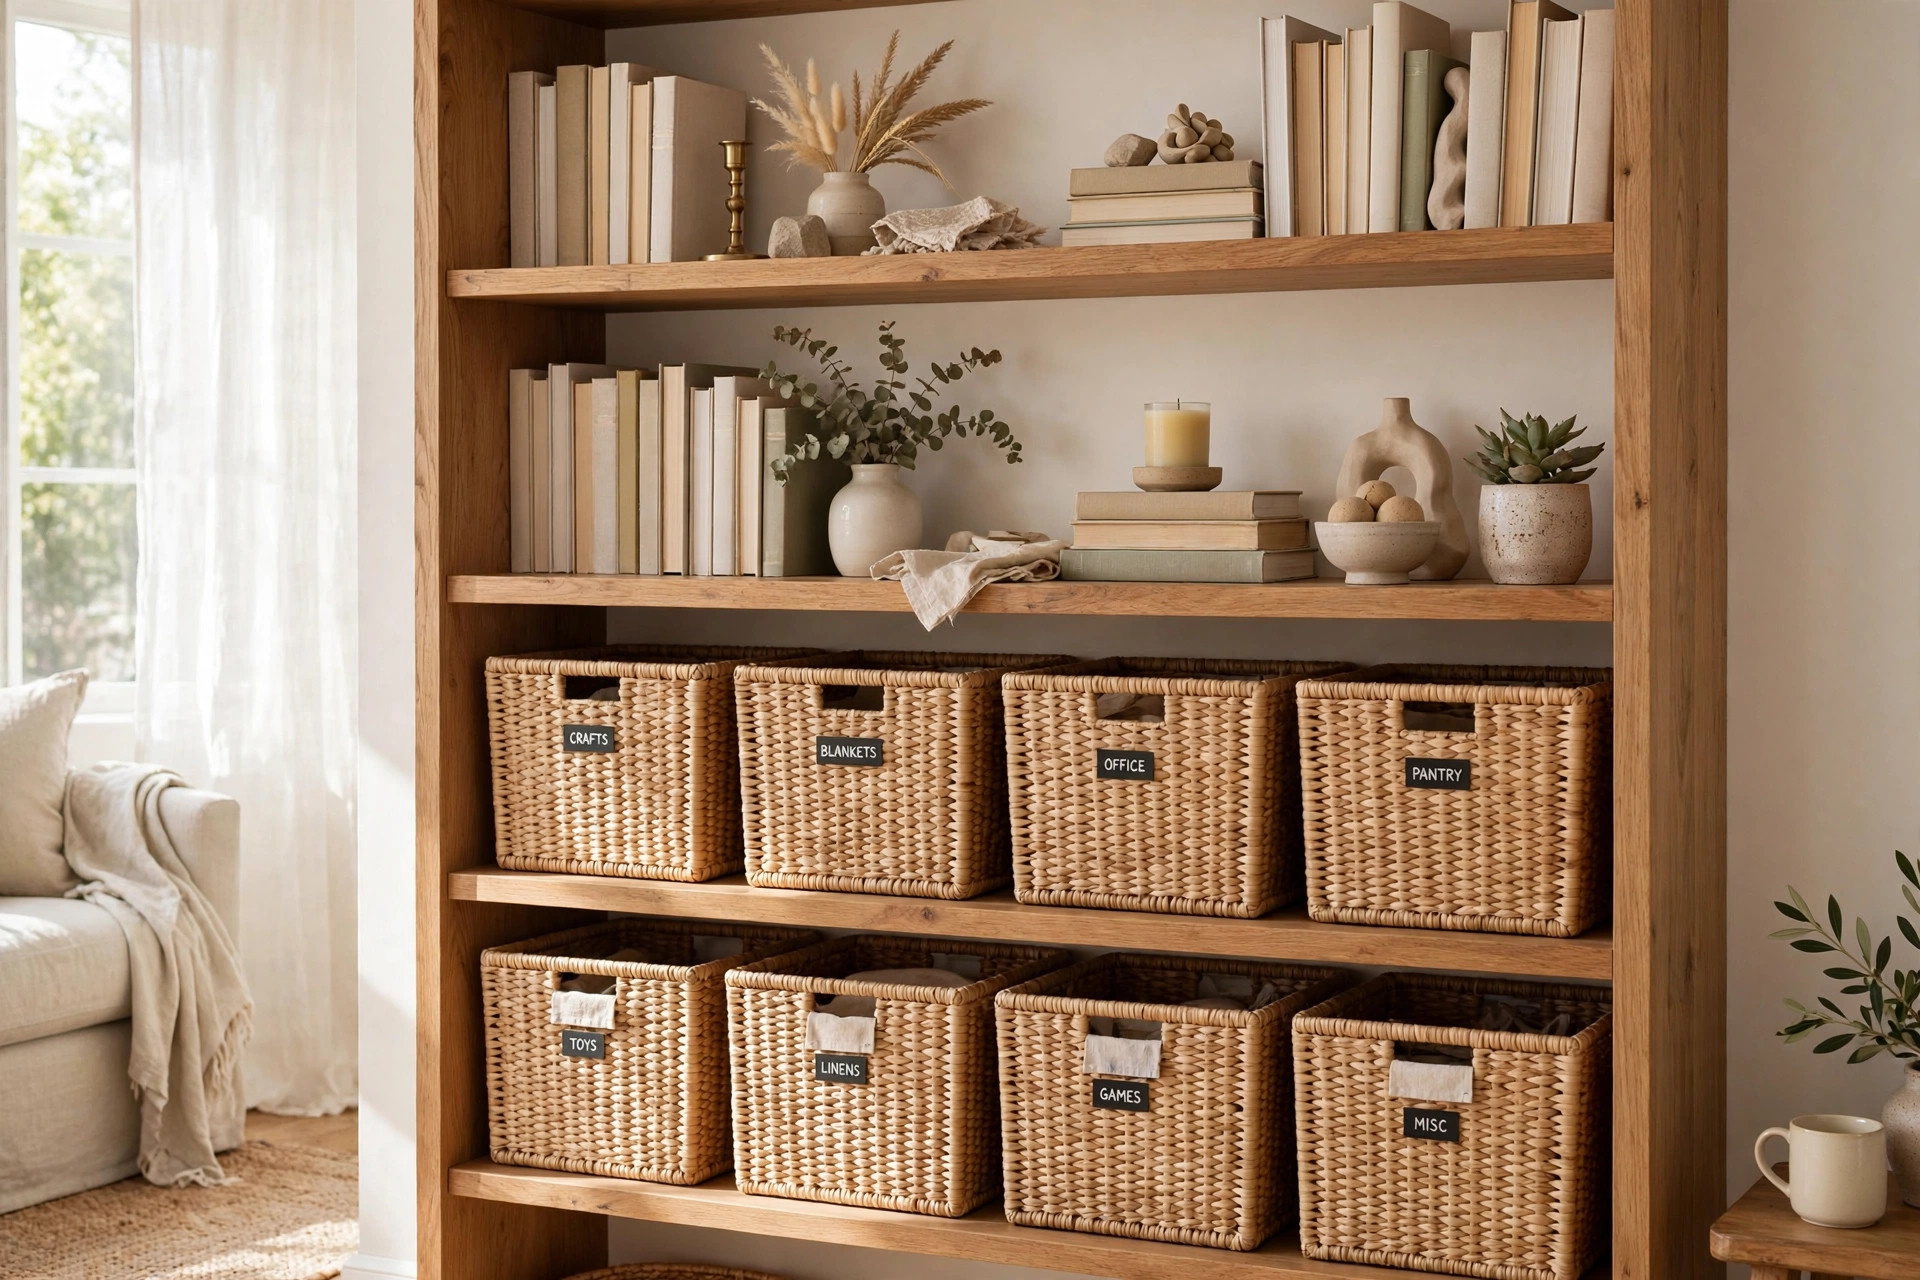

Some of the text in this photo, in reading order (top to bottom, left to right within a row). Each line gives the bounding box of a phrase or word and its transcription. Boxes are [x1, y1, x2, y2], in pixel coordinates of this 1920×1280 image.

[569, 731, 609, 746] CRAFTS
[820, 744, 877, 759] BLANKETS
[1104, 757, 1146, 773] OFFICE
[1412, 766, 1463, 782] PANTRY
[569, 1037, 597, 1052] TOYS
[821, 1061, 860, 1077] LINENS
[1099, 1087, 1141, 1104] GAMES
[1414, 1117, 1447, 1133] MISC
